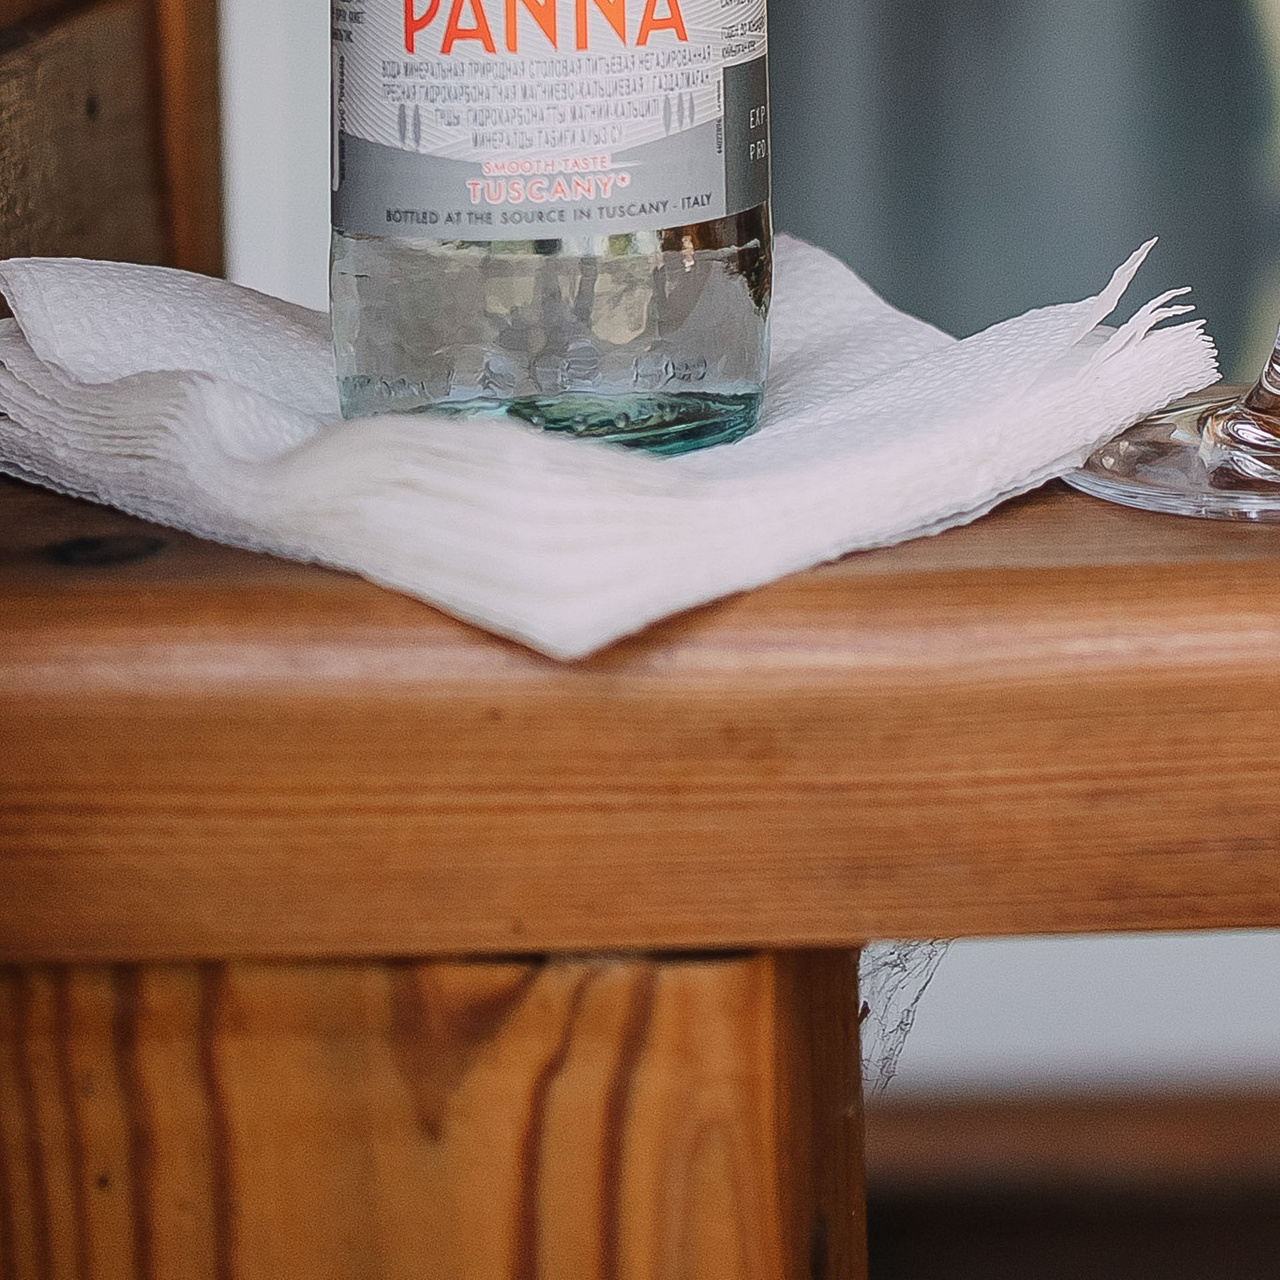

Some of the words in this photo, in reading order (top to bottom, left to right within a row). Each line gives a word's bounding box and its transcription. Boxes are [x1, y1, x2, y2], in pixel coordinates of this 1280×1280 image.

[468, 60, 525, 80] ПРИРОДНАЯ
[529, 57, 582, 79] СТОЛОВАЯ
[587, 54, 635, 75] ПИТЬЕВАЯ
[483, 159, 556, 175] SMOOTH
[562, 155, 608, 171] TASTE
[385, 209, 439, 226] BOTTLED
[444, 211, 462, 226] AT
[466, 211, 492, 225] THE
[500, 208, 566, 225] SOURCE
[573, 209, 591, 220] IN
[598, 199, 669, 219] TUSCANY
[681, 192, 713, 211] ITALY
